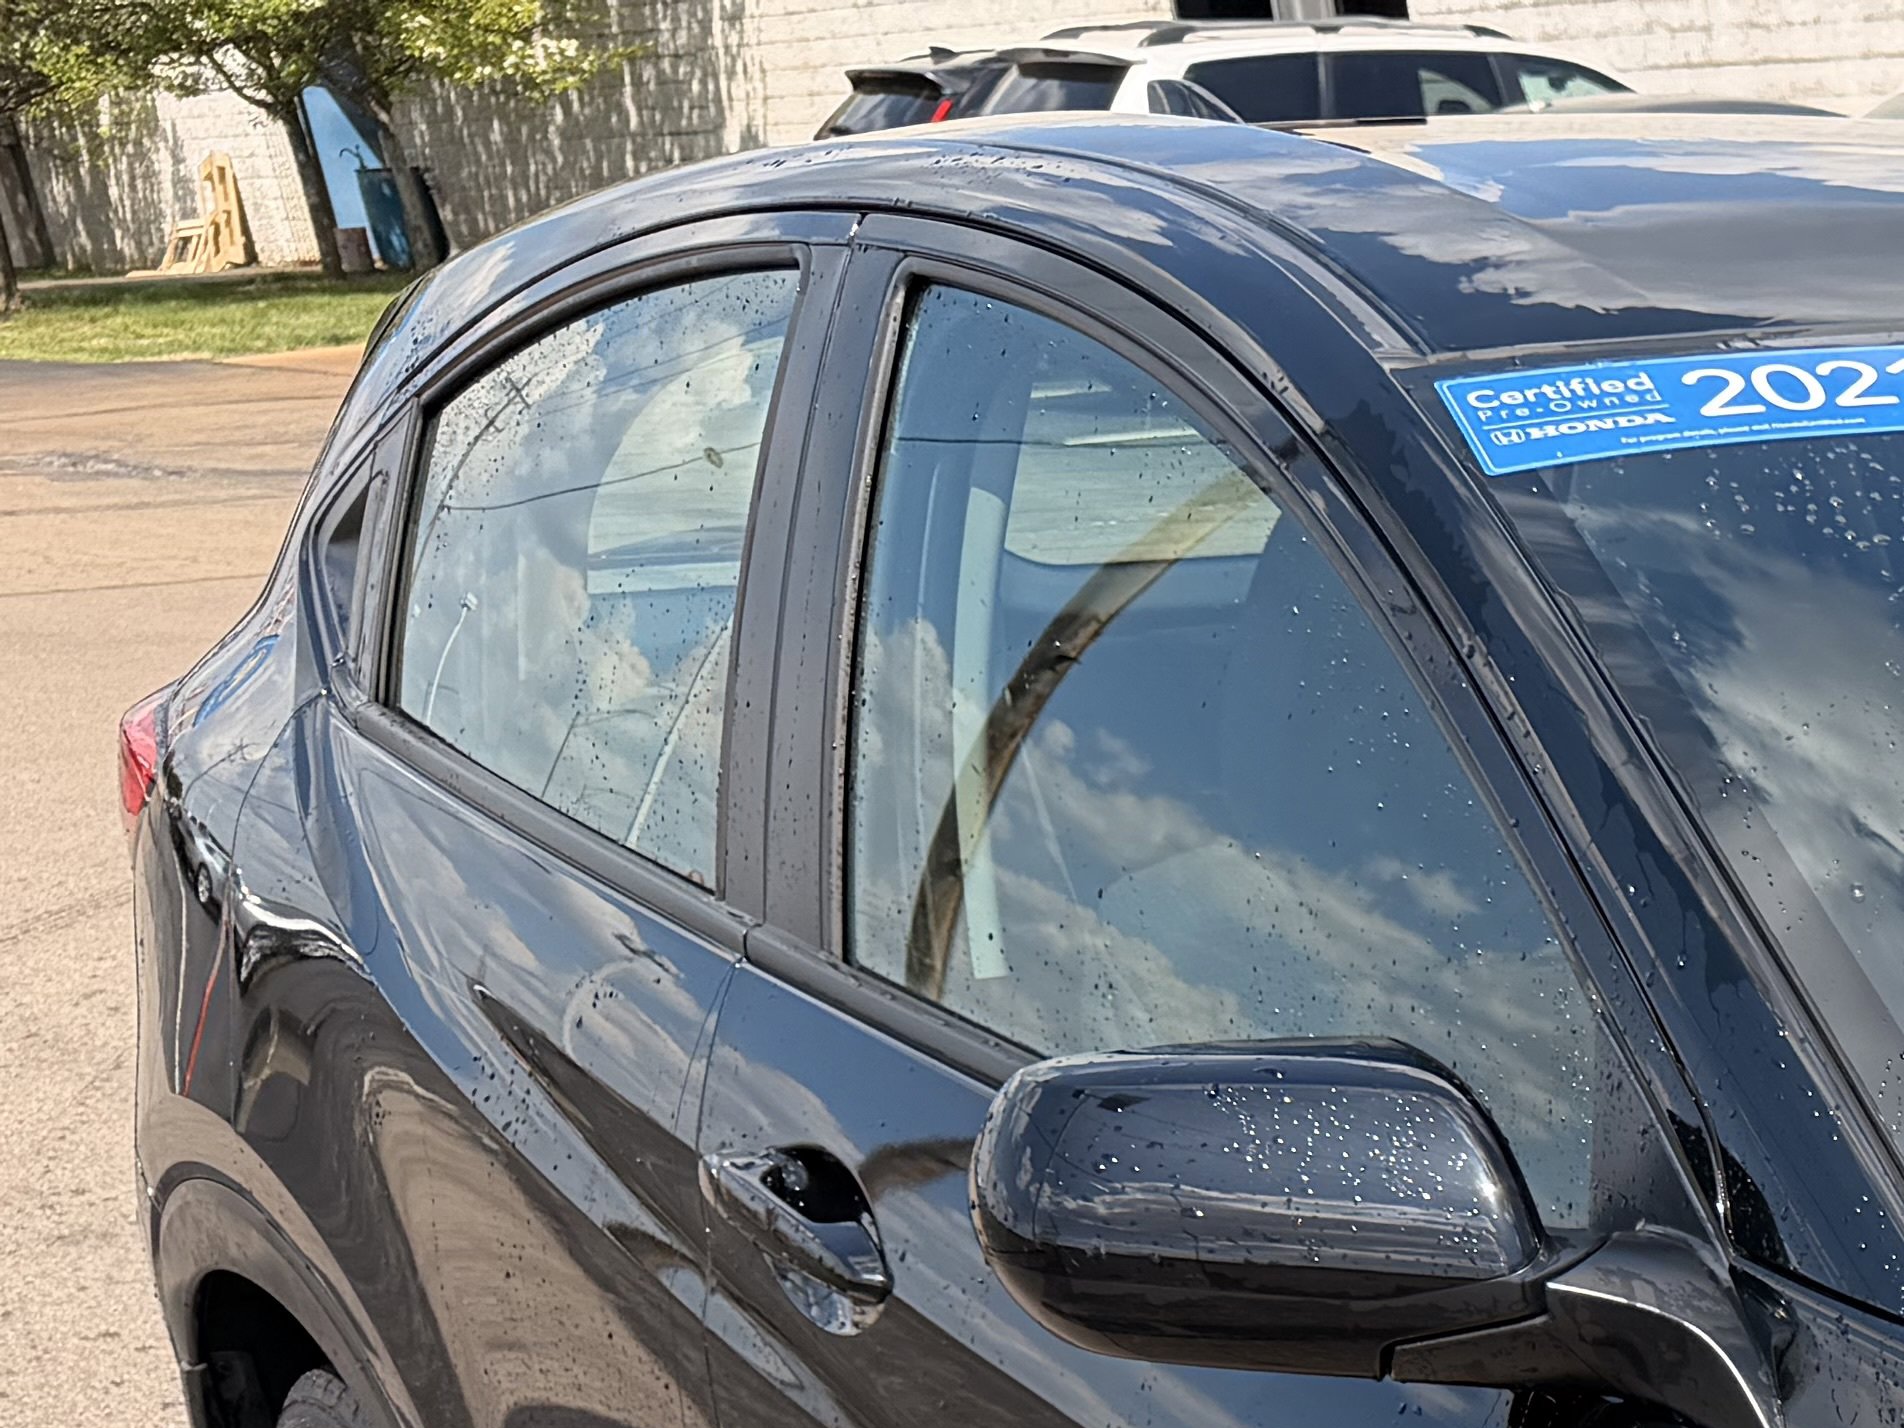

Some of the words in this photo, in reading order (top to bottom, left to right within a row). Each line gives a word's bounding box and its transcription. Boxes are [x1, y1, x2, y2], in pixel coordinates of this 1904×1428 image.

[1466, 371, 1656, 409] Certified
[1476, 390, 1663, 422] Pre-Owned
[1526, 411, 1677, 440] HONDA
